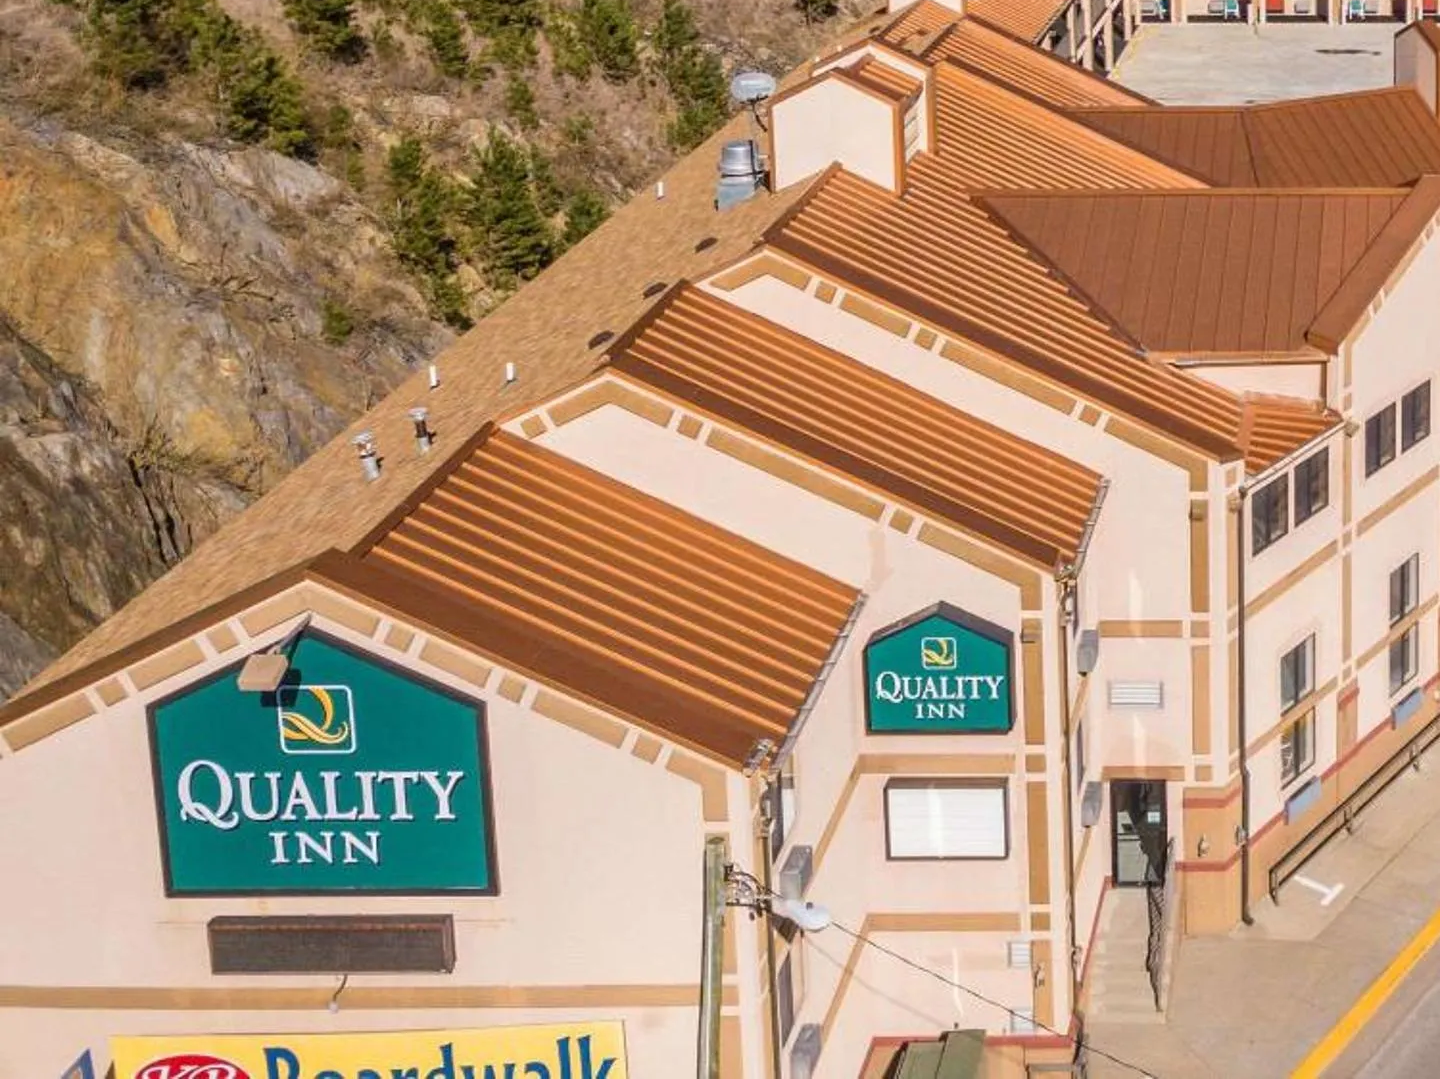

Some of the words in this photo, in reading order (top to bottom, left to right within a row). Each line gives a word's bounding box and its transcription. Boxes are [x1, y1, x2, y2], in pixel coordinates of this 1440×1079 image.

[876, 671, 1004, 703] QUALITY
[915, 703, 965, 719] INN
[177, 759, 464, 830] QUALITY
[268, 831, 381, 864] INN
[263, 1034, 617, 1079] Bdalk
